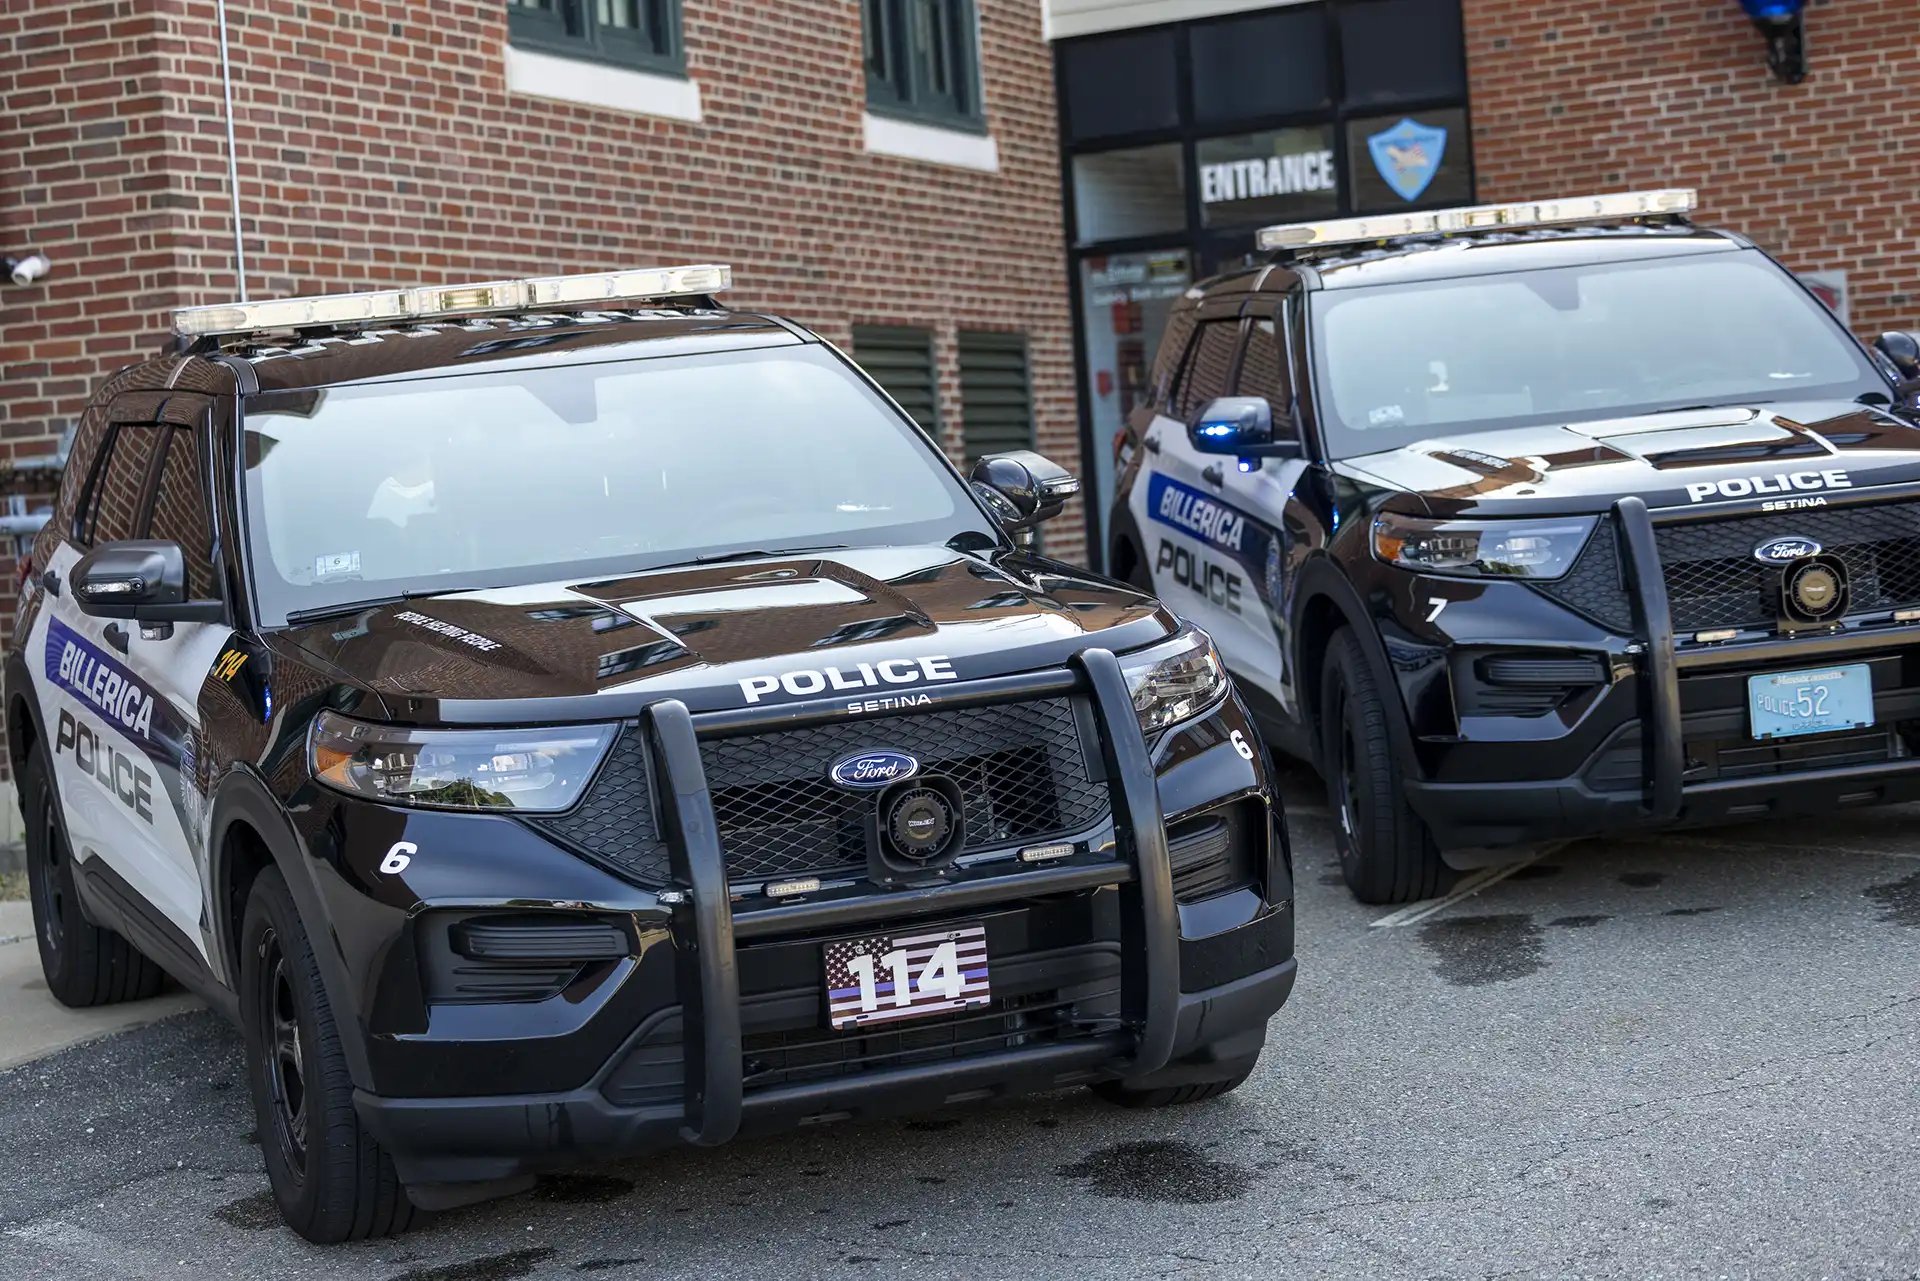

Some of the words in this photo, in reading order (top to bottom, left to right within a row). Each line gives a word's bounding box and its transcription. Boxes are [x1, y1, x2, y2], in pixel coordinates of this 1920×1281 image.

[1201, 150, 1336, 203] ENTRANCE
[1684, 469, 1852, 503] POLICE
[1160, 486, 1245, 550] BILLERICA
[1761, 496, 1828, 512] SETINA
[1156, 538, 1242, 615] POLICE
[1425, 596, 1448, 622] 7
[213, 649, 249, 682] 114
[738, 655, 958, 704] POLICE
[58, 640, 155, 739] BILLERICA
[847, 693, 932, 714] SETINA
[1757, 694, 1796, 718] POLICE
[1796, 685, 1831, 718] 52
[1230, 729, 1254, 760] 6
[56, 707, 154, 826] POLICE
[380, 841, 418, 874] 6
[847, 941, 966, 1012] 114
